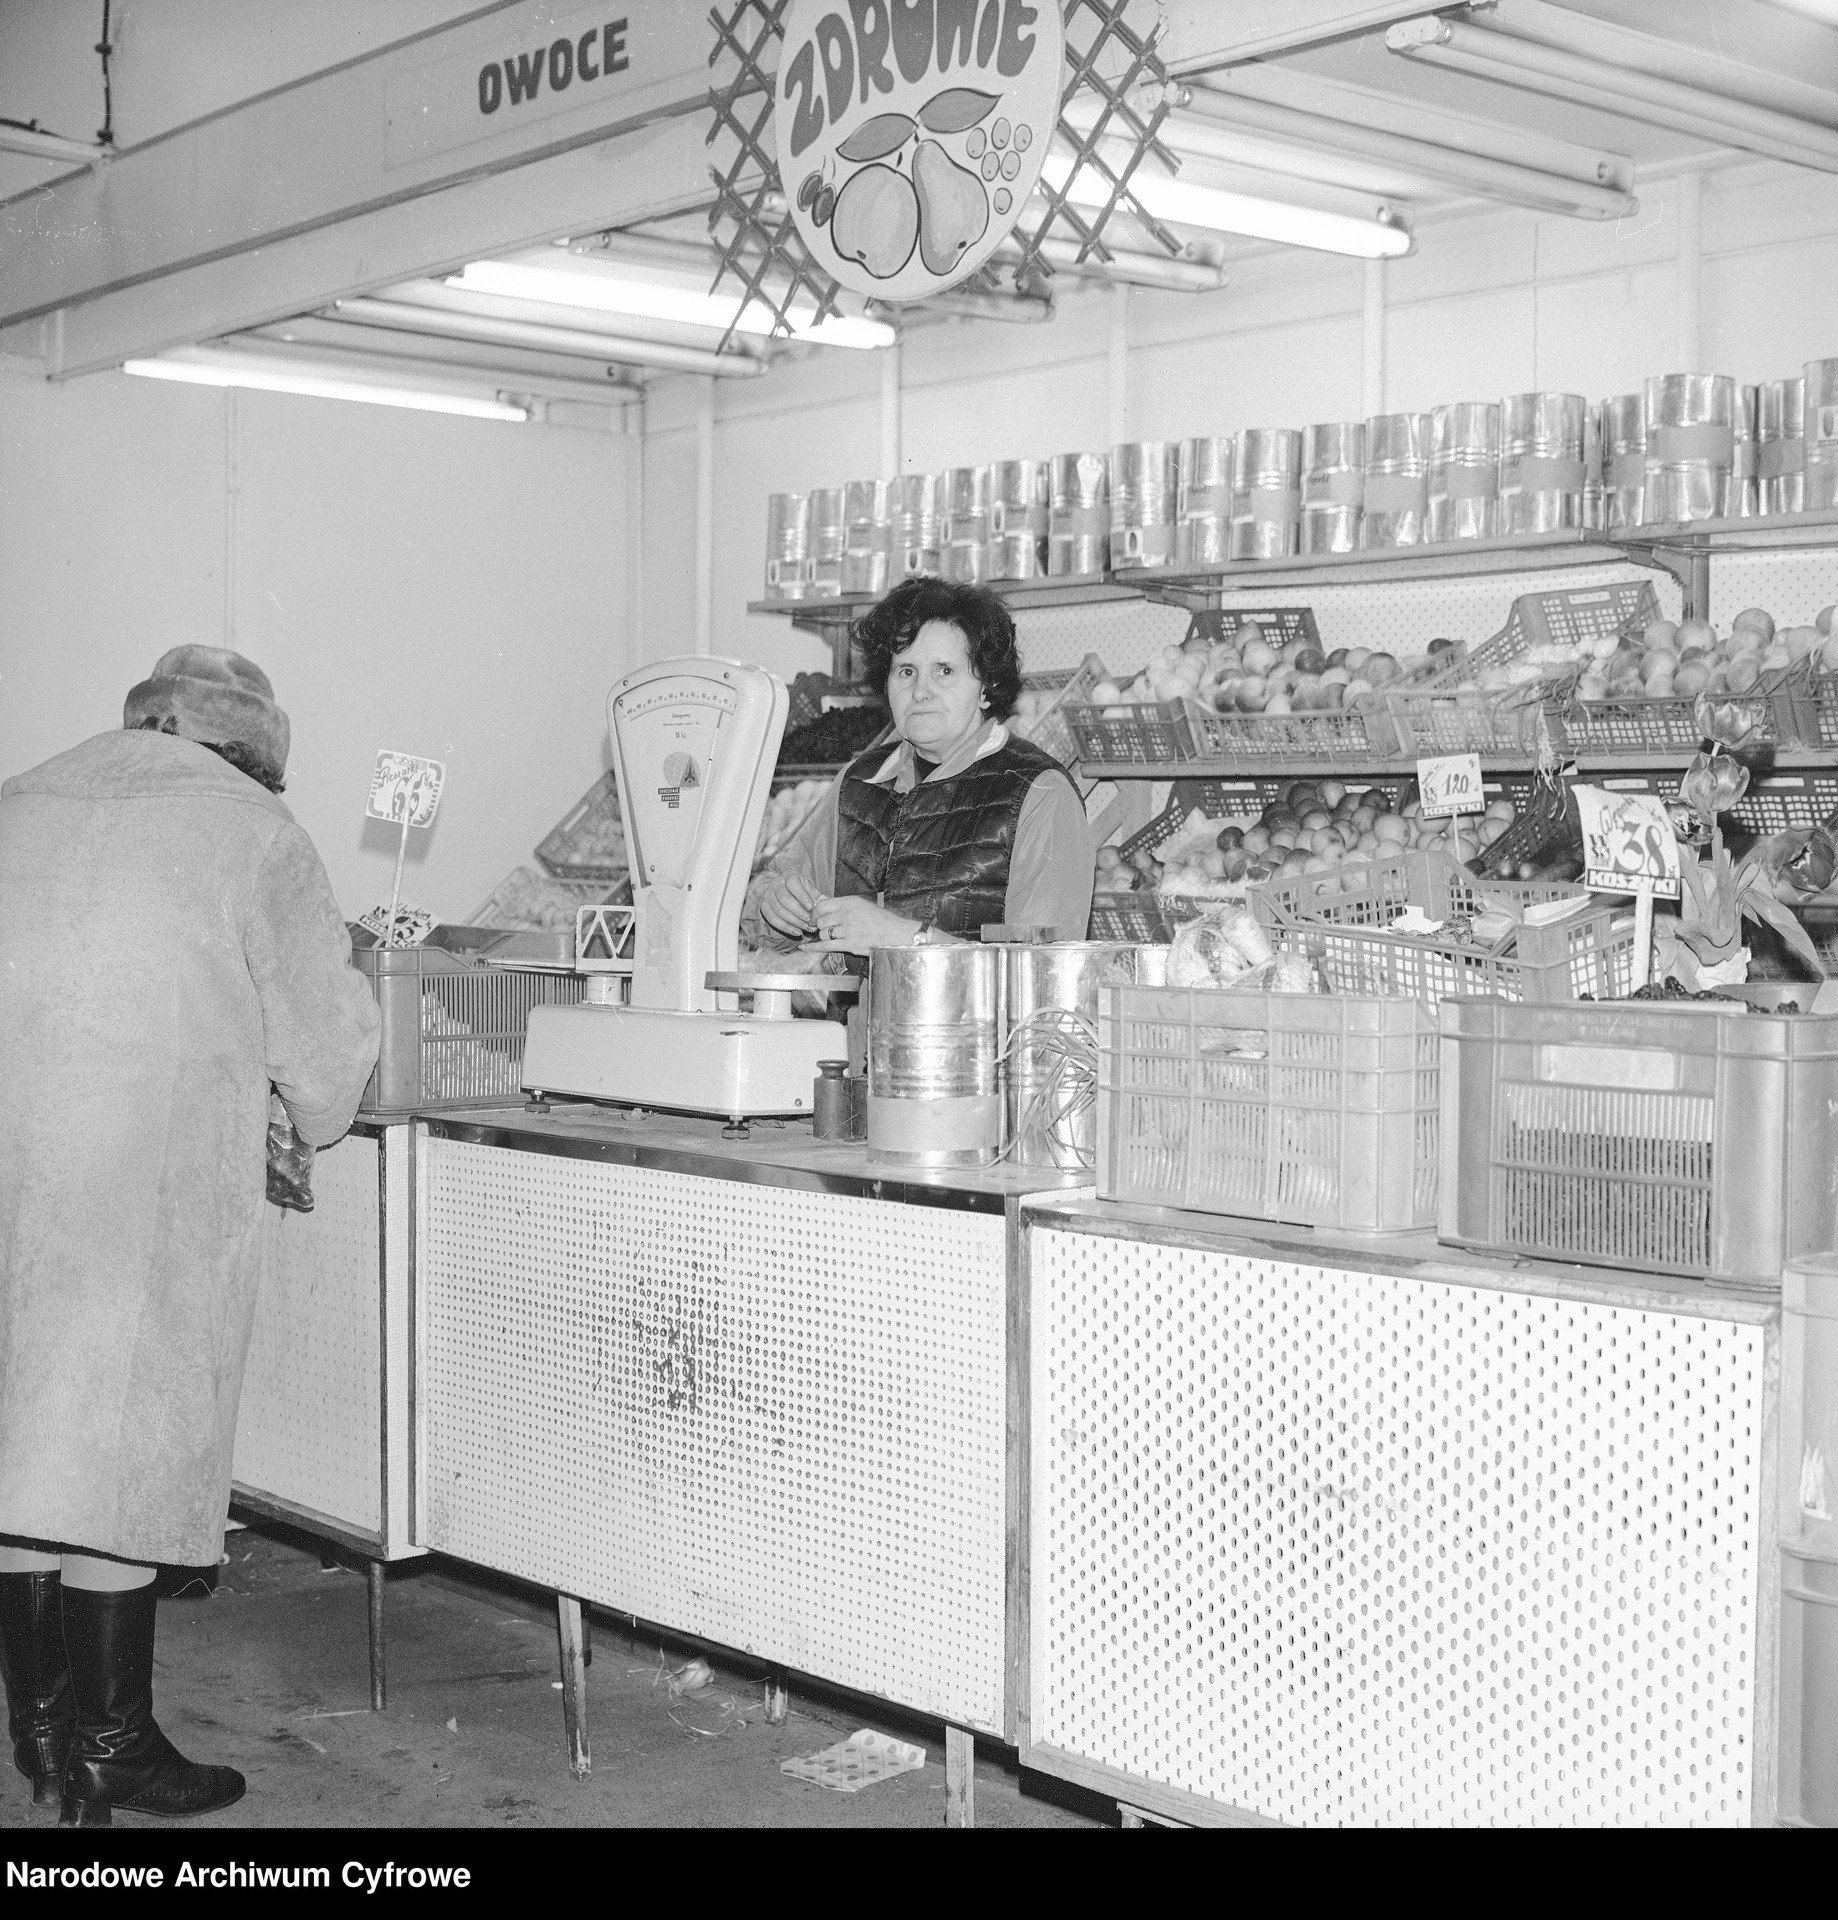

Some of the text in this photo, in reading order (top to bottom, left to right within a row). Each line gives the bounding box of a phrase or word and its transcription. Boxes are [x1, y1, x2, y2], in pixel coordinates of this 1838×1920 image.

[478, 17, 630, 115] OWOCE
[784, 0, 1038, 158] ZDROWIE
[1424, 803, 1481, 816] KOSZYKI
[1442, 774, 1471, 797] 120
[1613, 822, 1665, 879] 38
